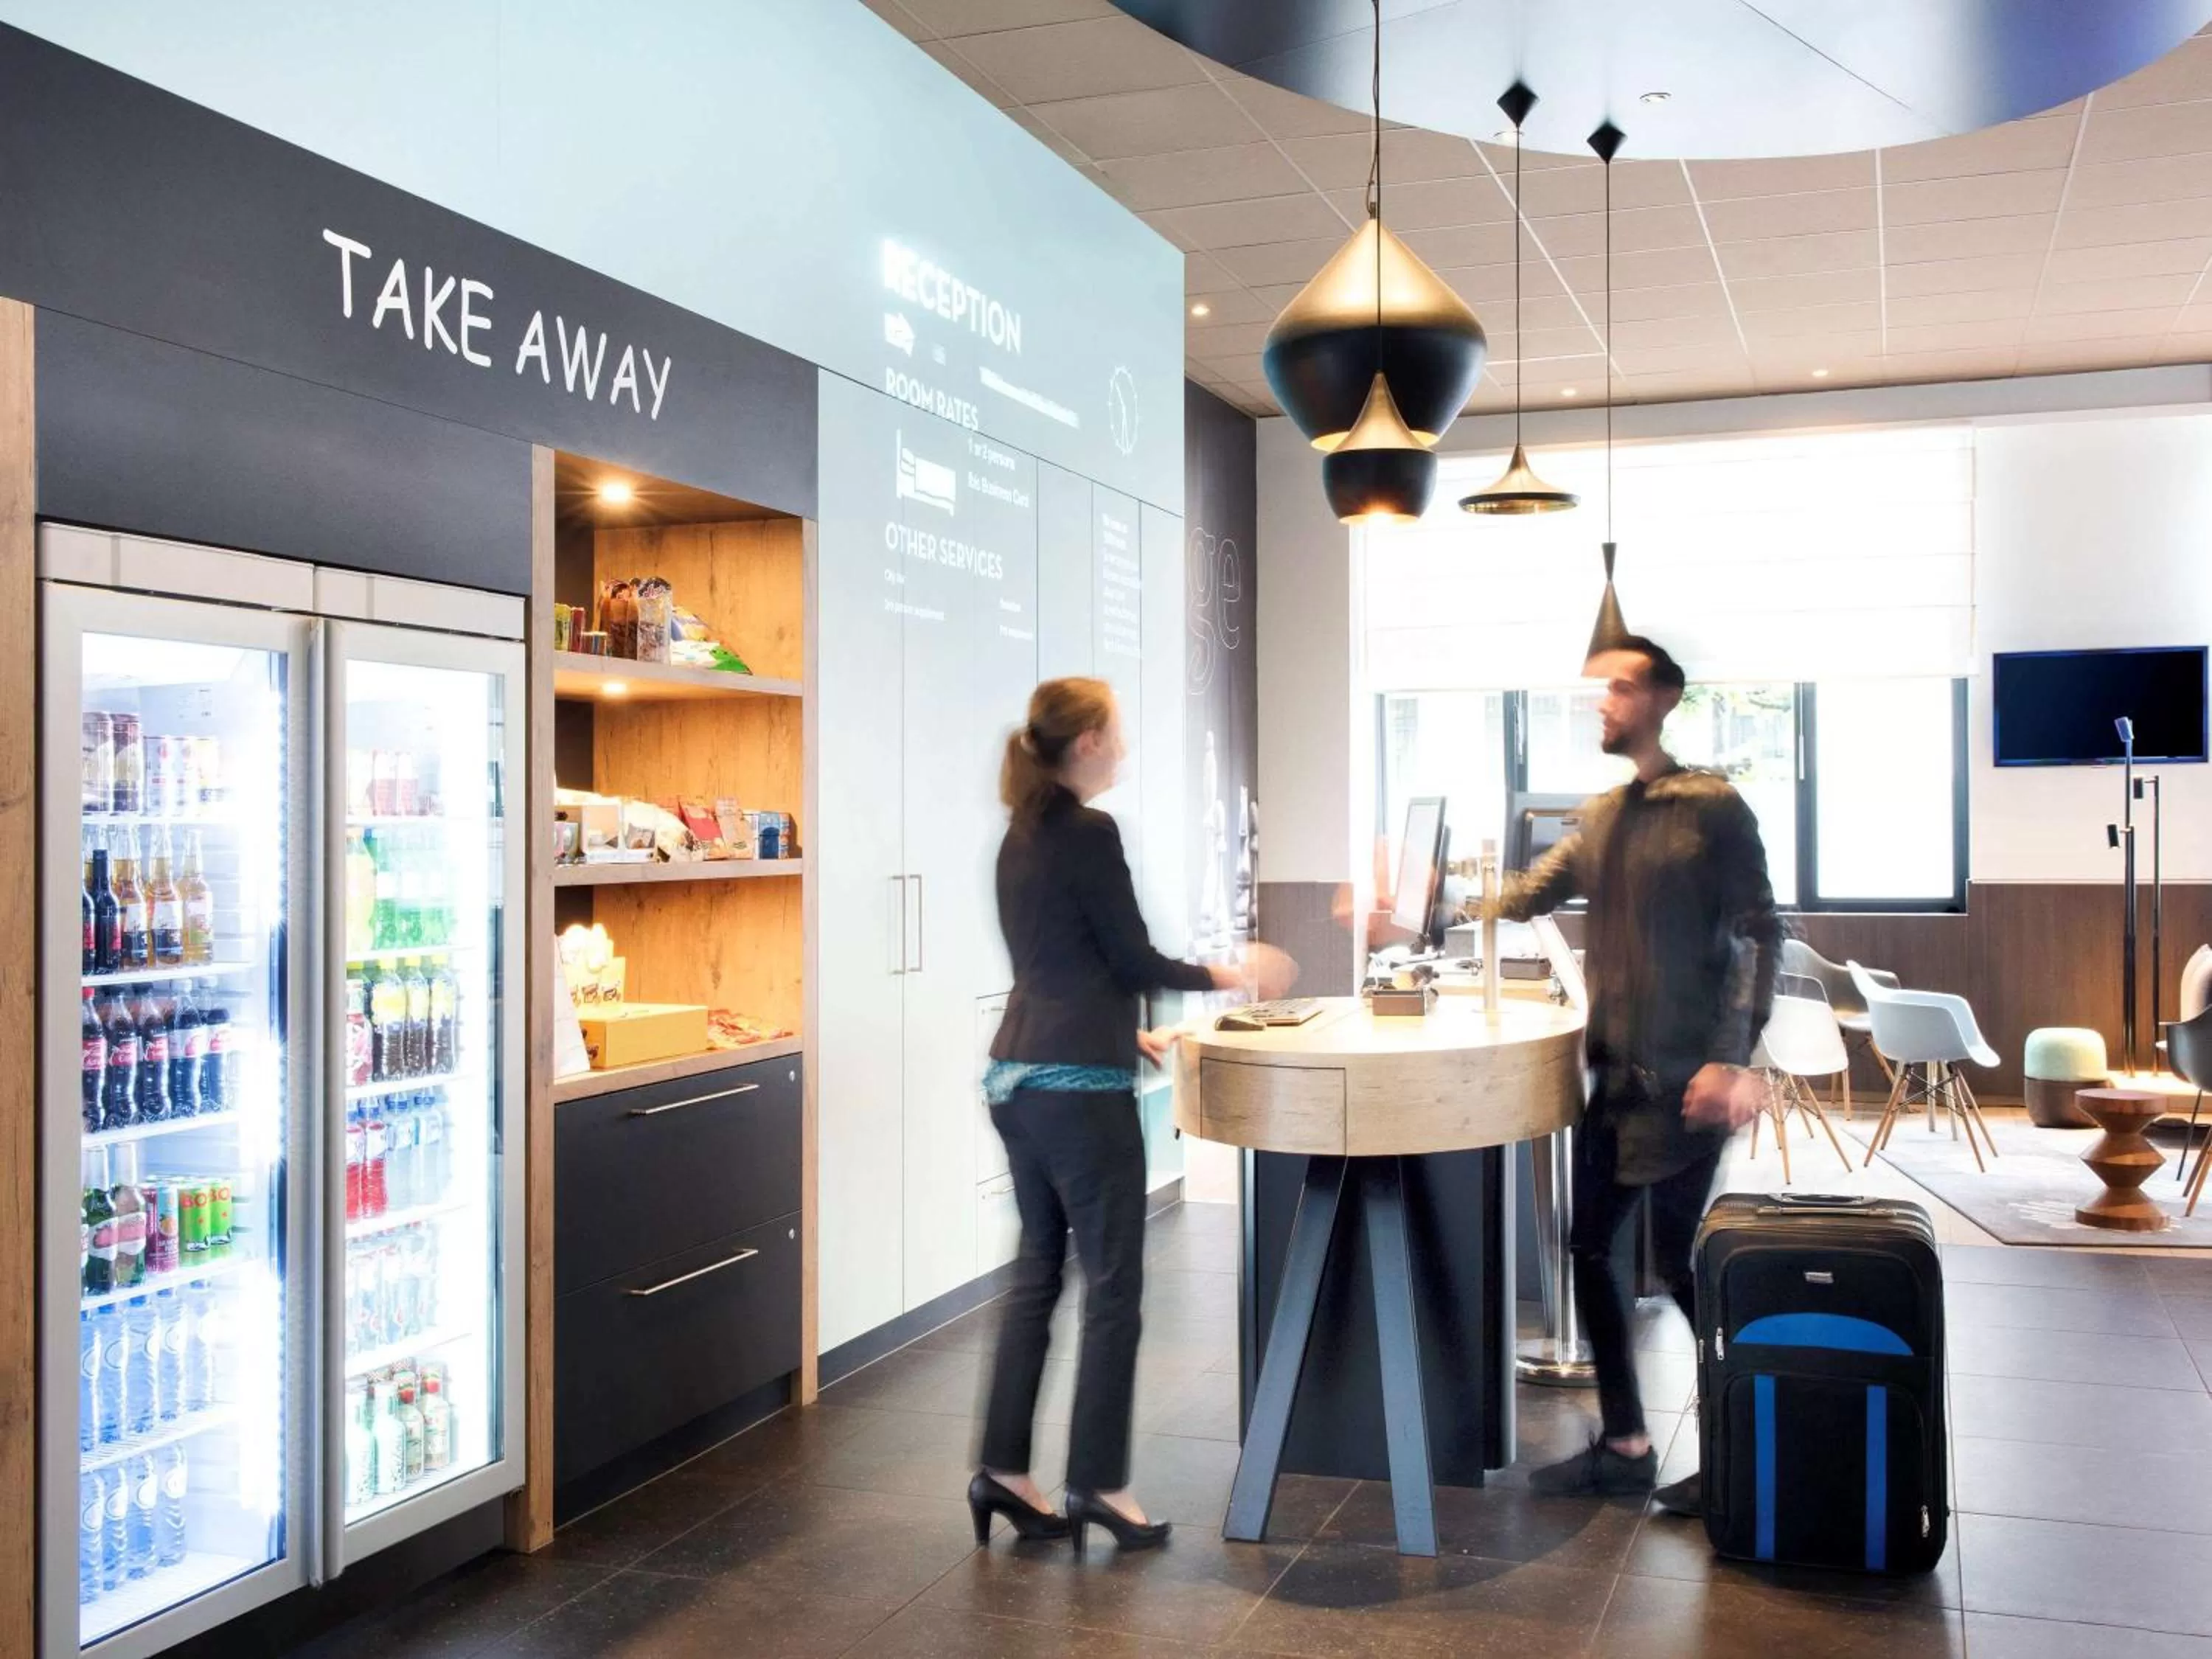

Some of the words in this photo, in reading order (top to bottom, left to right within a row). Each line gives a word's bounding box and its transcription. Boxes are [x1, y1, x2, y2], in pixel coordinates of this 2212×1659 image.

[322, 228, 494, 368] TAKE
[515, 310, 672, 420] AWAY
[886, 366, 933, 411] ROOM
[936, 389, 978, 431] RATES
[885, 522, 936, 565] OTHER
[939, 538, 1004, 580] SERVICES
